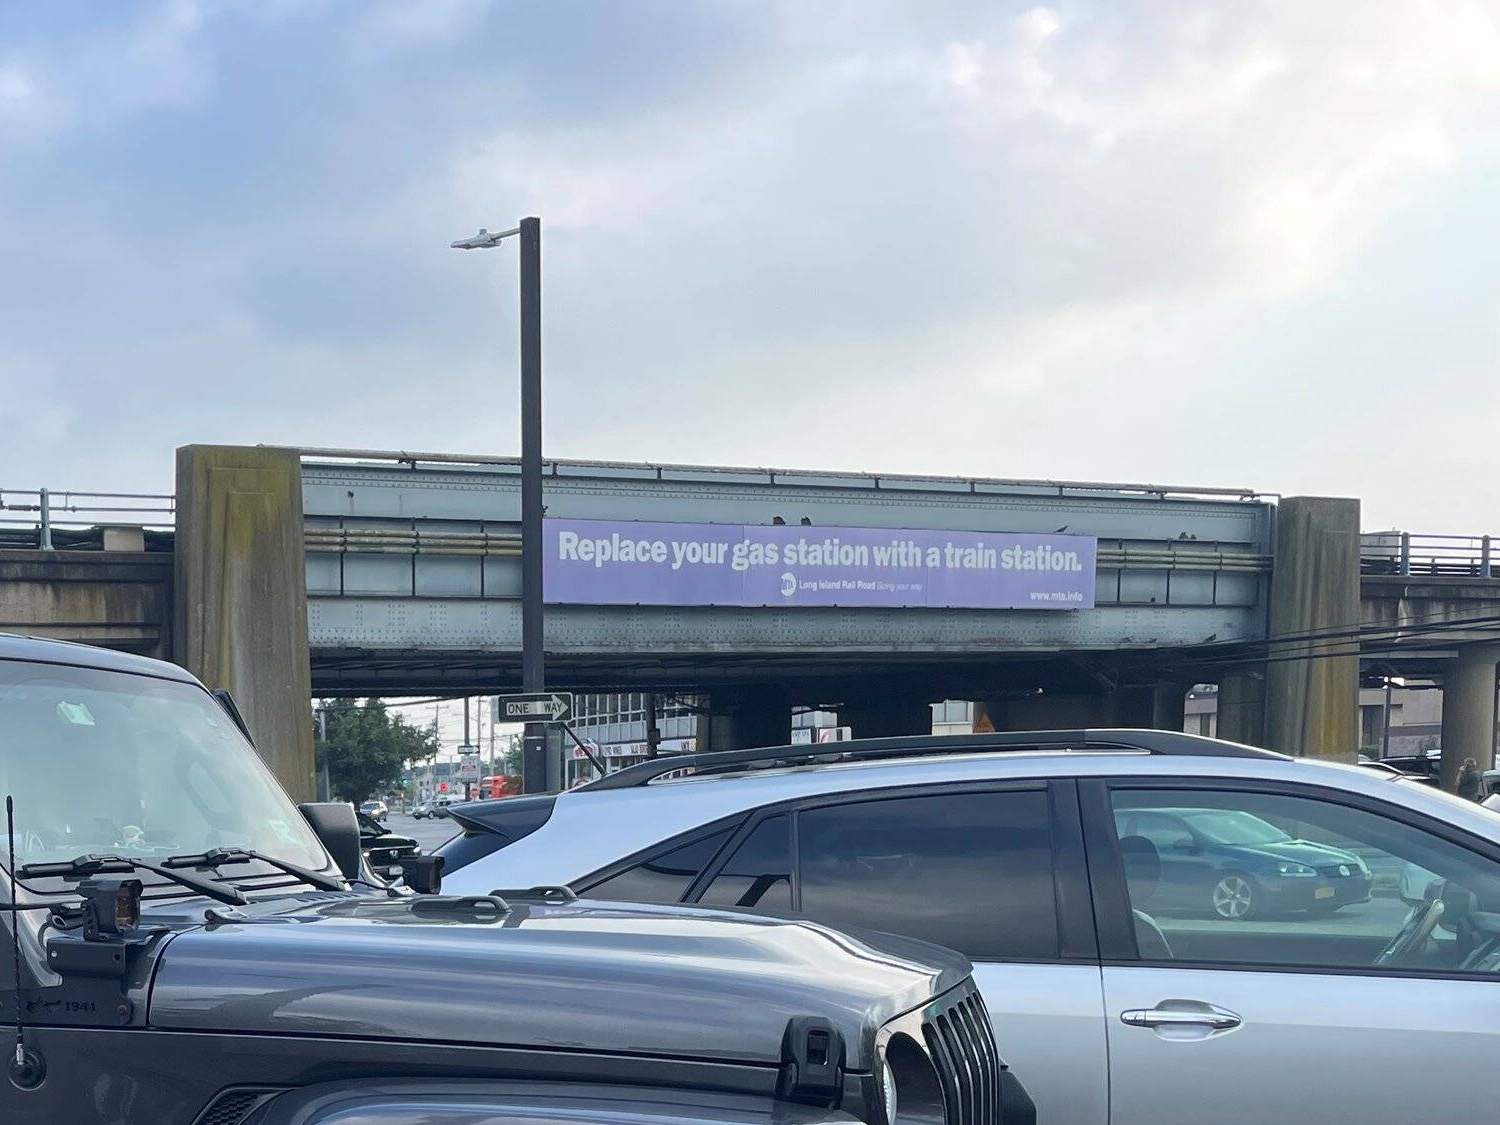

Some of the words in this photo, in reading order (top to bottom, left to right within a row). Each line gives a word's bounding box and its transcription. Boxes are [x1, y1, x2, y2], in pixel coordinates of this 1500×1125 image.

[558, 531, 667, 568] Replace
[671, 541, 729, 570] your
[731, 539, 780, 571] gas
[782, 538, 869, 567] station
[872, 540, 923, 568] with
[925, 547, 941, 568] a
[944, 542, 997, 569] train
[1000, 544, 1083, 571] station.
[799, 580, 818, 592] Long
[818, 579, 841, 590] Island
[842, 580, 856, 590] Rail
[857, 580, 876, 590] Road
[1029, 590, 1083, 602] www.mta.info
[508, 703, 530, 714] ONE
[543, 702, 563, 713] WAY
[65, 1000, 96, 1012] 1941
